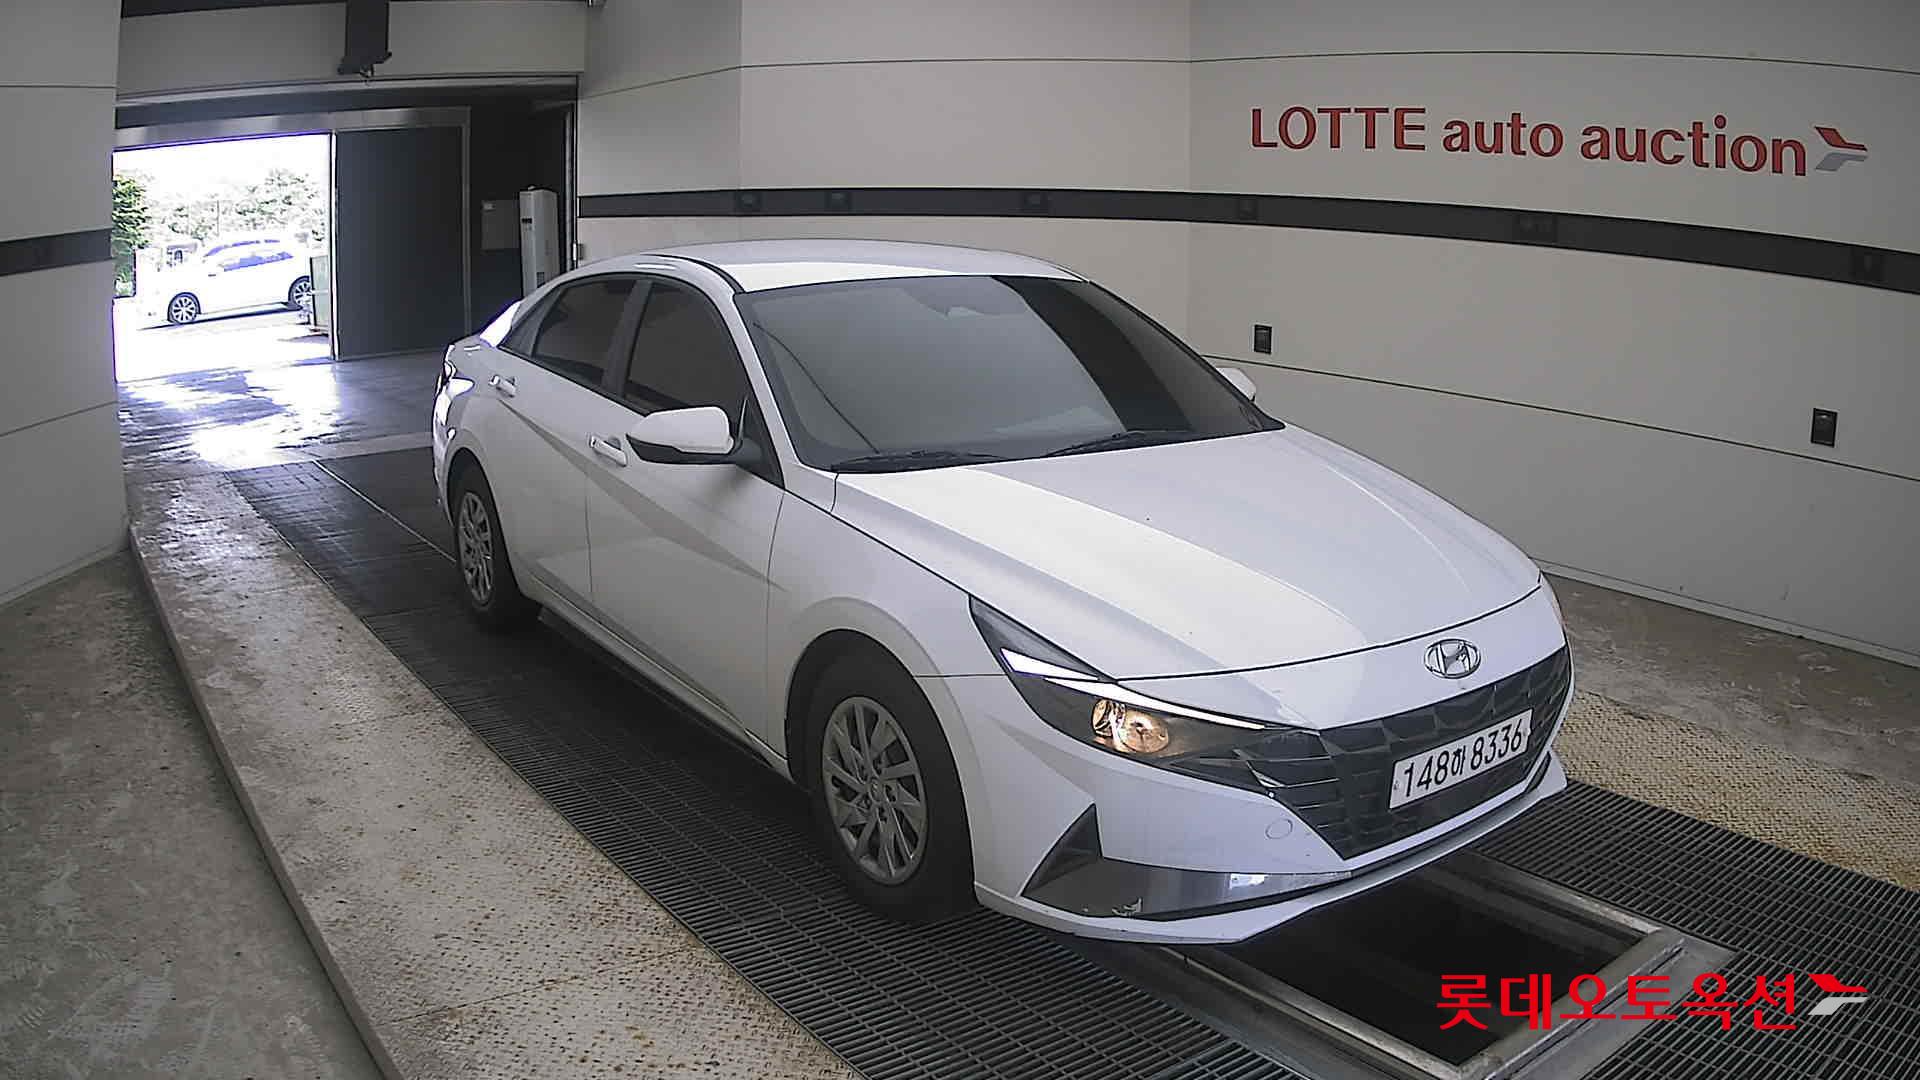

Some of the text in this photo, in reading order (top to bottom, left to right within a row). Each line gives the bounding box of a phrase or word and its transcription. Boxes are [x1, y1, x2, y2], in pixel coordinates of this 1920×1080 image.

[1250, 106, 1807, 177] LOTTE auto auction
[1471, 719, 1523, 771] 8336
